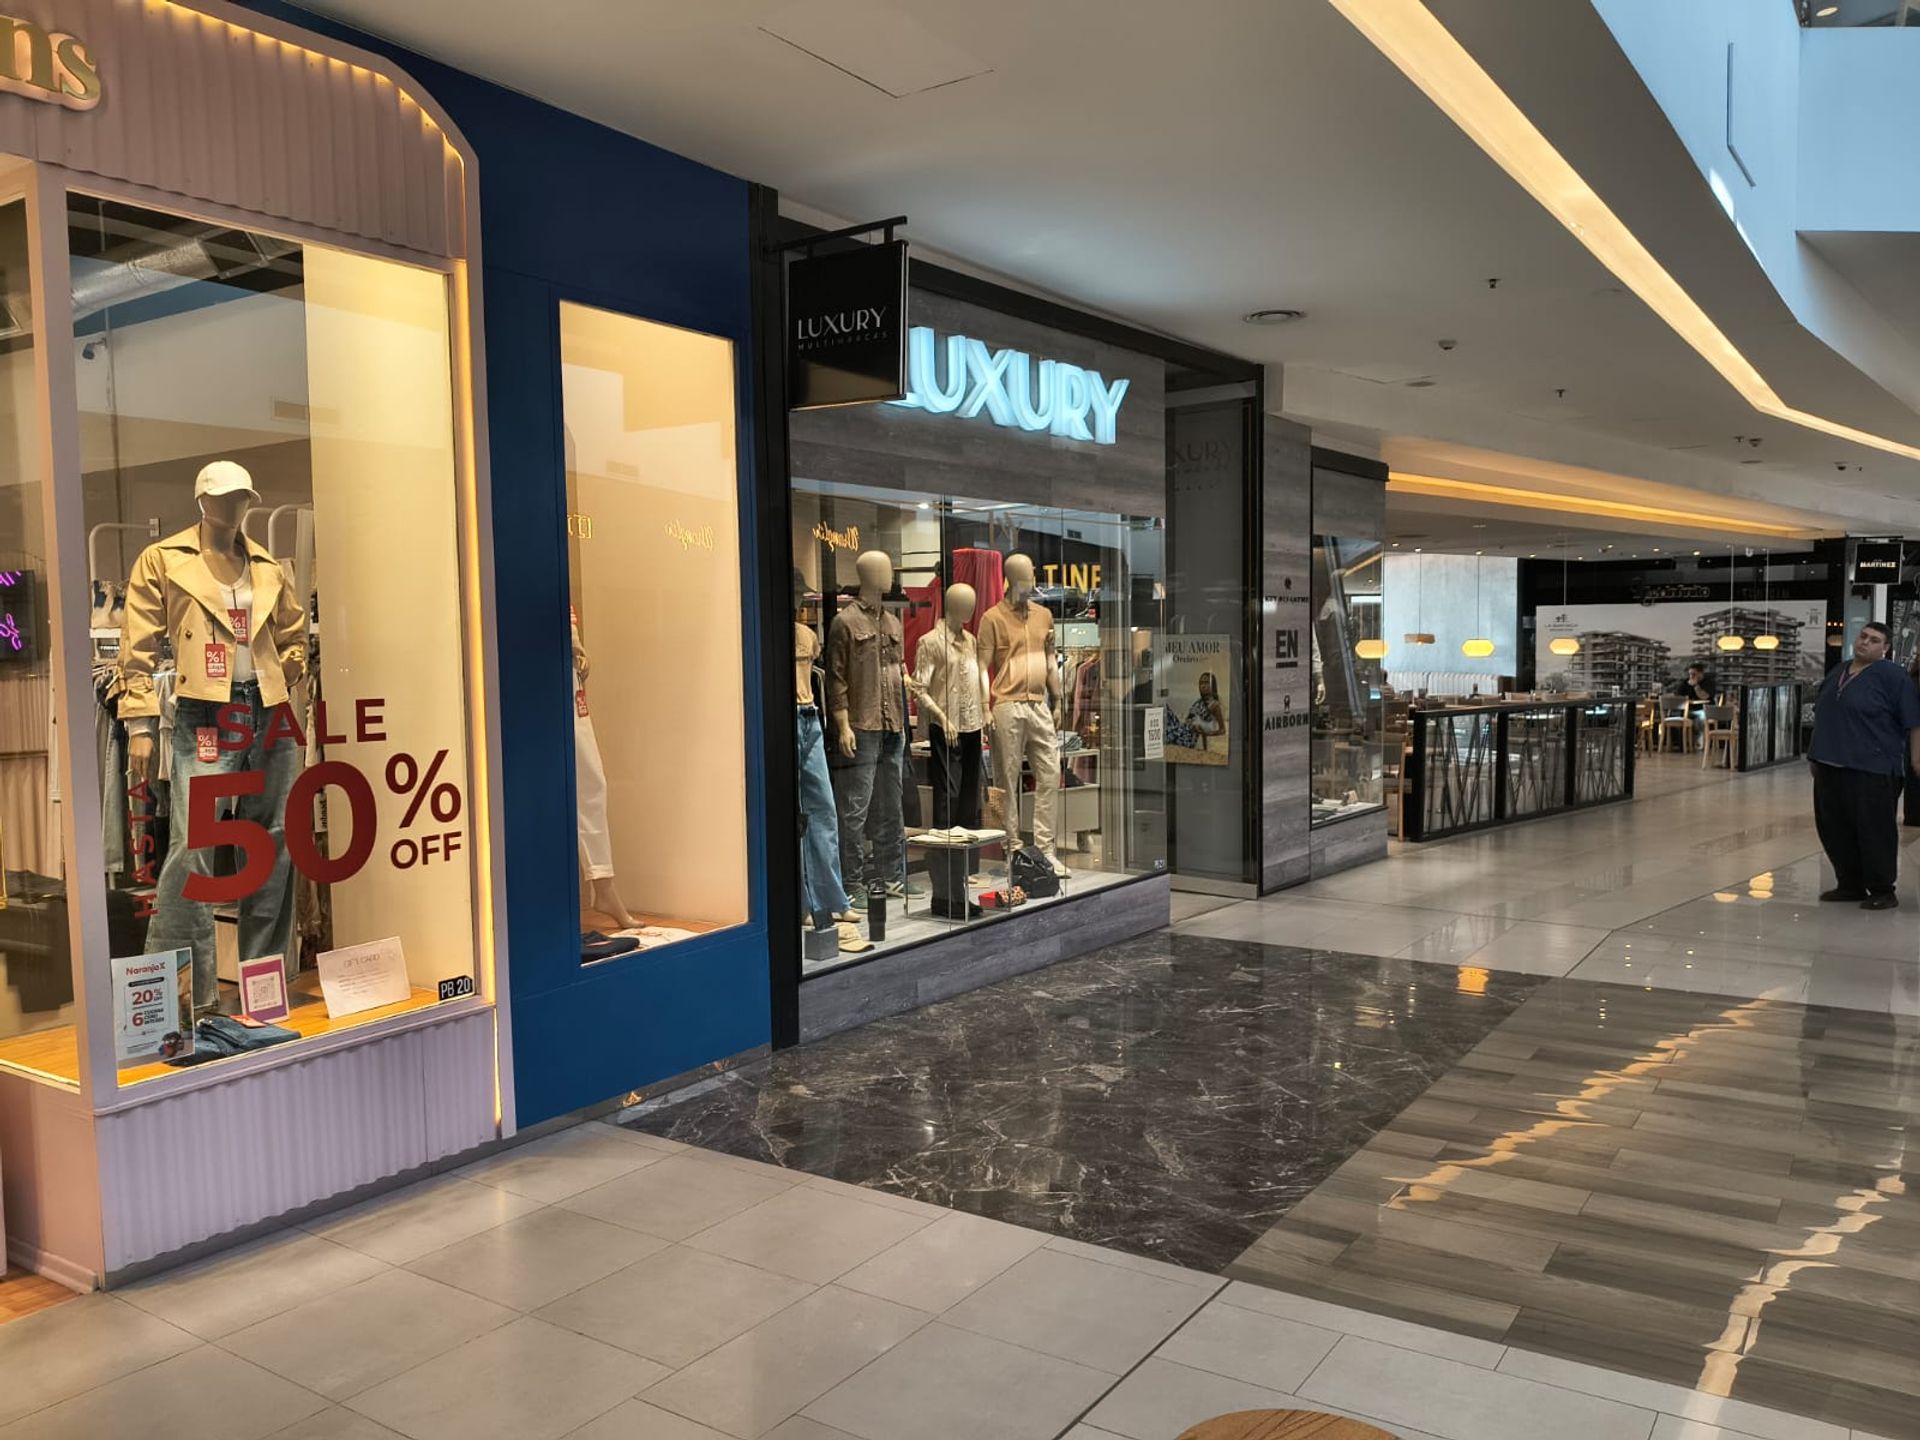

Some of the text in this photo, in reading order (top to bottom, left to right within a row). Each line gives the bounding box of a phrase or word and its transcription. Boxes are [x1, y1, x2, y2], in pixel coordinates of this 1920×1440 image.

[797, 306, 888, 340] LUXURY
[1033, 563, 1102, 593] TINE
[1188, 640, 1220, 654] AMOR
[1275, 629, 1299, 660] EN
[216, 698, 387, 751] SALE
[1264, 713, 1309, 731] AIRBORN
[390, 831, 462, 870] OFF
[131, 989, 154, 1006] 20
[440, 978, 471, 999] PB 20
[132, 1012, 143, 1027] 6
